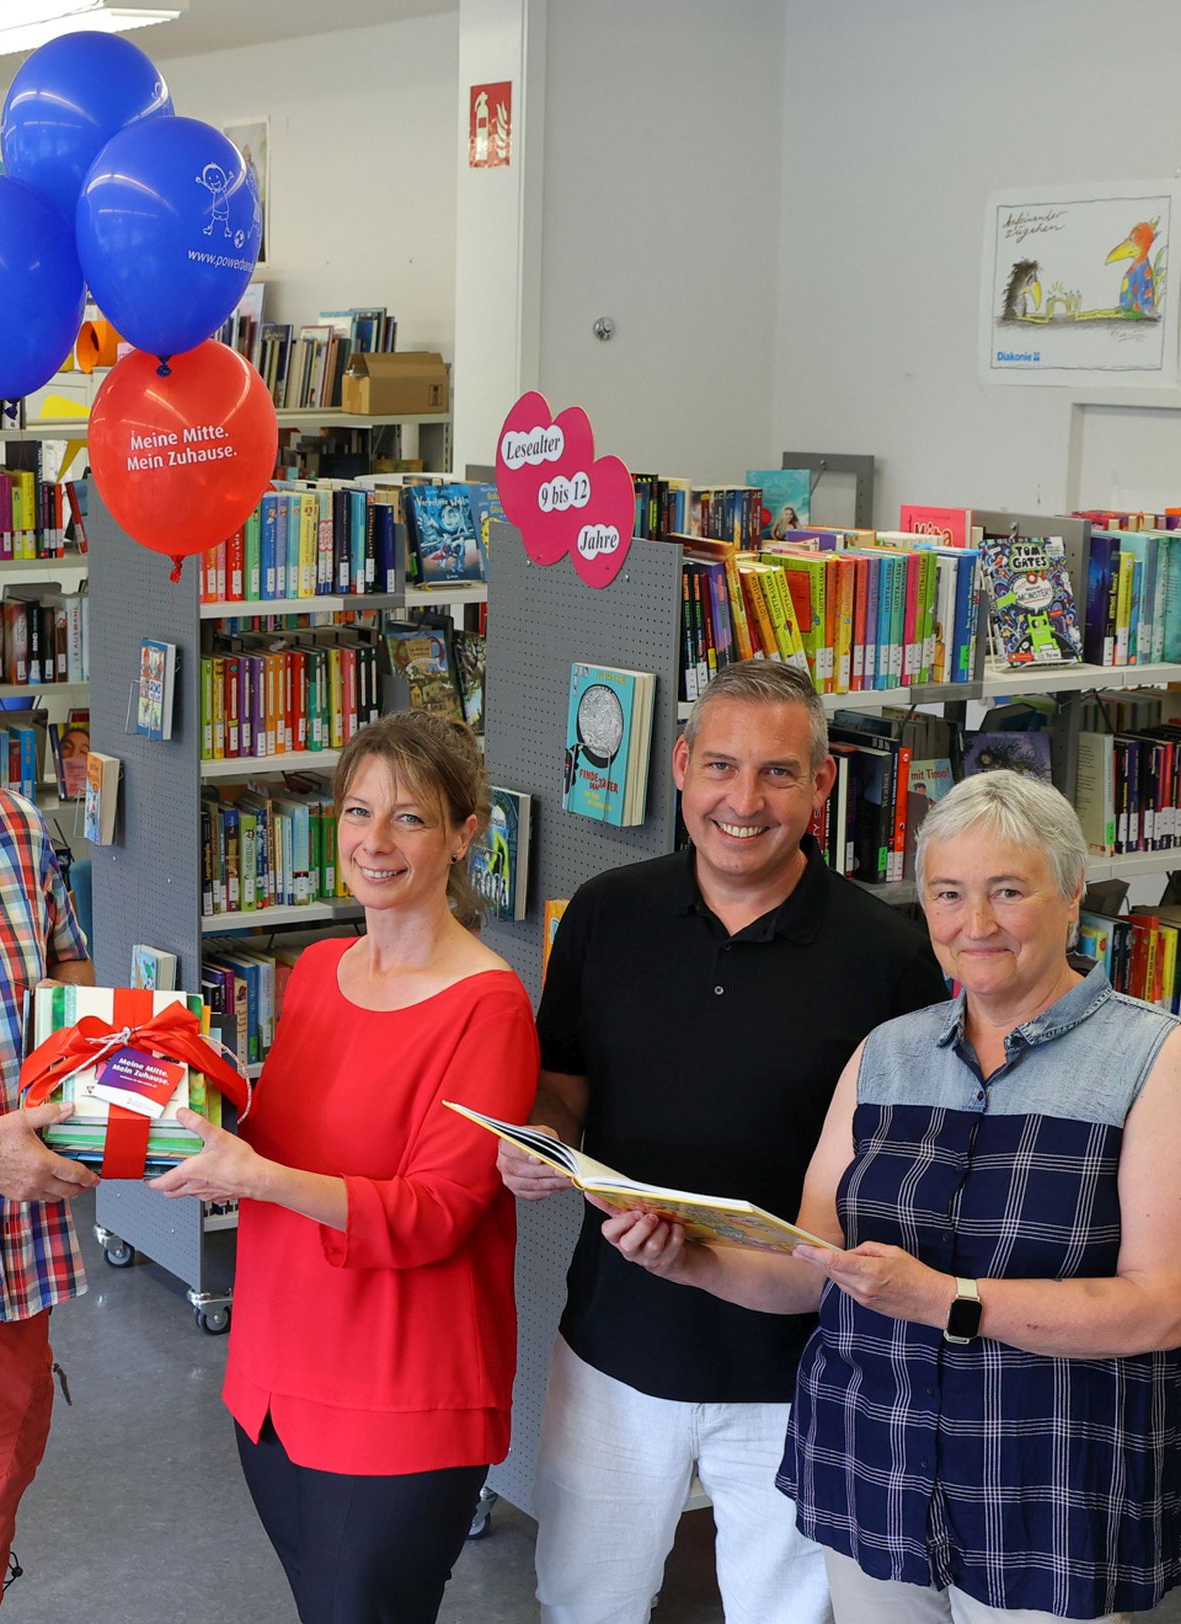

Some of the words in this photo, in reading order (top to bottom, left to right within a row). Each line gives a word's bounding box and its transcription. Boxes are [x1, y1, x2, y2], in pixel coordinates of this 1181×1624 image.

[997, 351, 1032, 361] Diakonie
[131, 432, 178, 451] Meine
[183, 425, 229, 443] Mitte.
[506, 435, 561, 461] Lesealter
[127, 454, 163, 471] Mein
[169, 445, 237, 466] Zuhause.
[542, 487, 549, 507] 9
[552, 487, 569, 505] bis
[574, 480, 588, 501] 12
[580, 530, 617, 551] Jahre
[1015, 546, 1041, 557] TOM
[1013, 557, 1047, 570] GATES
[911, 770, 925, 780] mit
[926, 768, 951, 780] Timo!
[112, 1064, 133, 1074] Mein
[134, 1070, 170, 1086] Zuhause.
[119, 1058, 144, 1070] Meine
[145, 1065, 169, 1077] Mitte.
